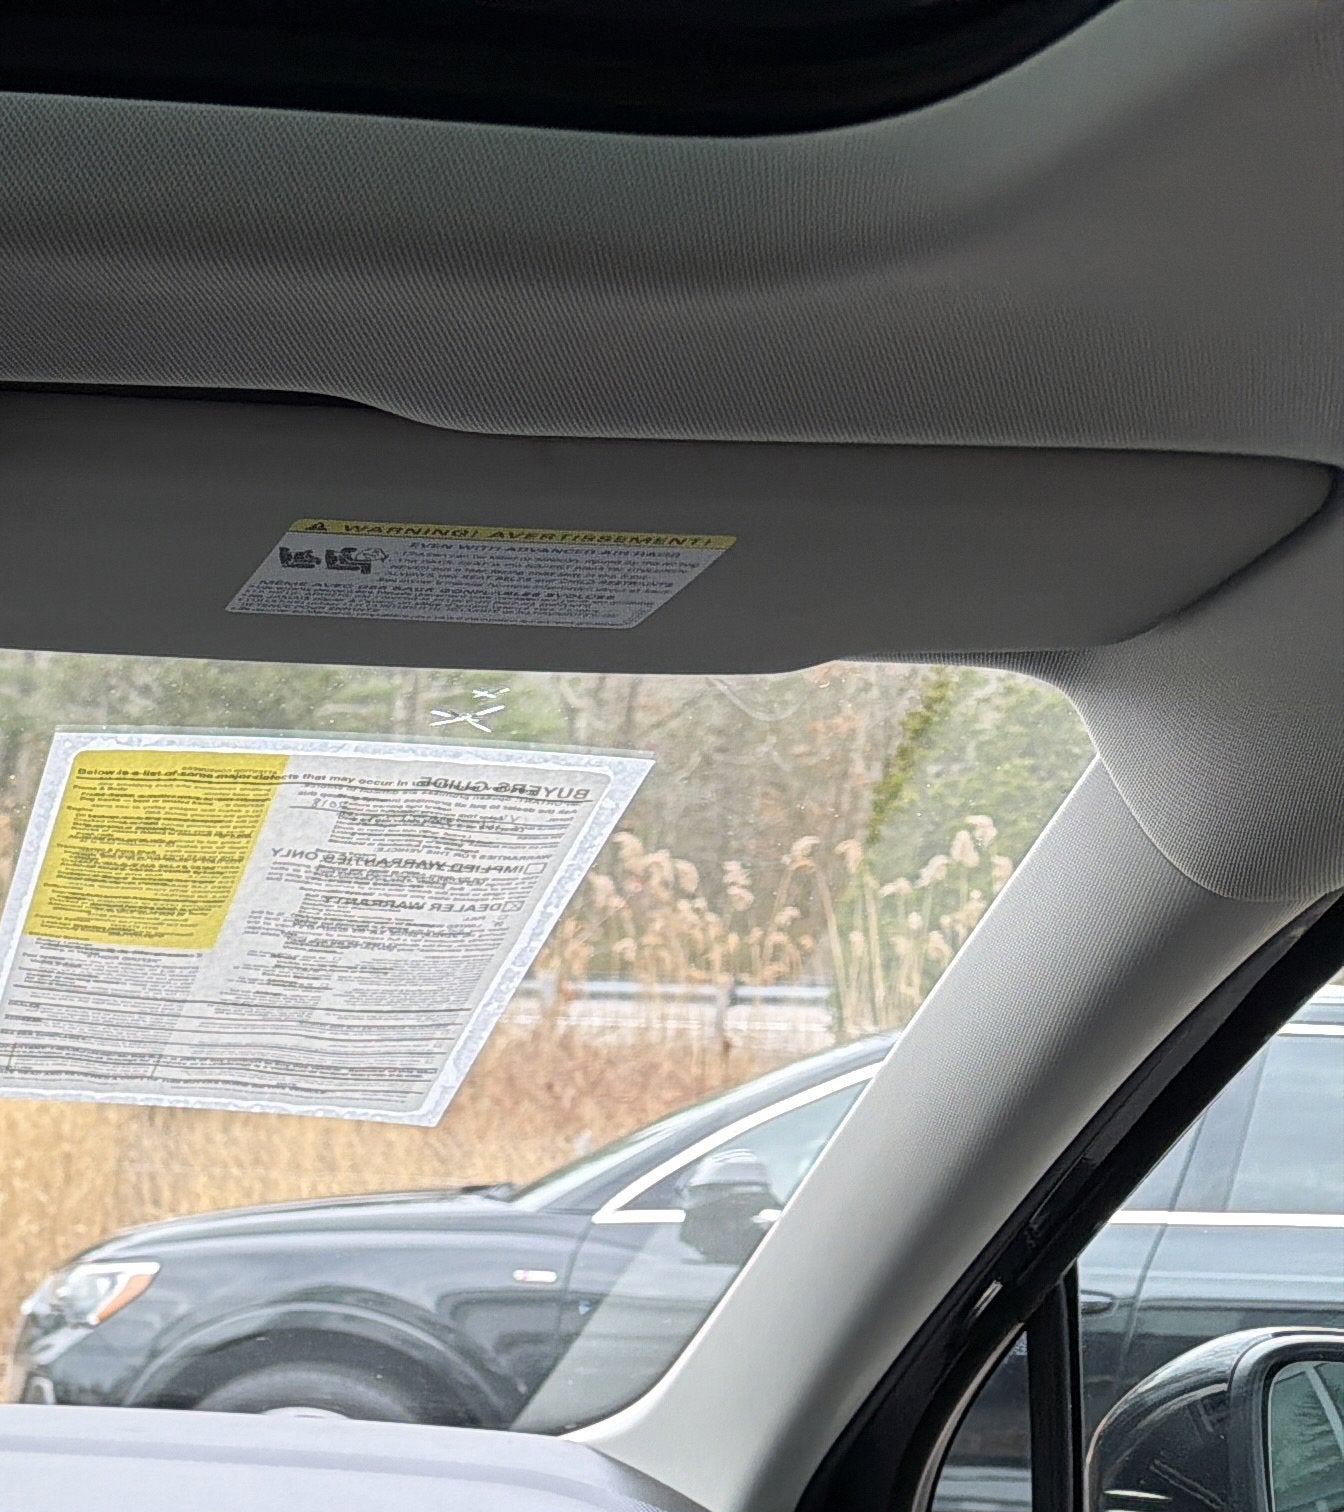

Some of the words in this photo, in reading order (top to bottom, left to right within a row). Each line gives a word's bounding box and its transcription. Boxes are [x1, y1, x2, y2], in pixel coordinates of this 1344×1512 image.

[344, 525, 479, 539] WARNING!
[488, 531, 712, 547] AVERTISSEMENT!
[302, 773, 327, 781] that
[330, 774, 355, 785] may
[359, 778, 394, 786] occur
